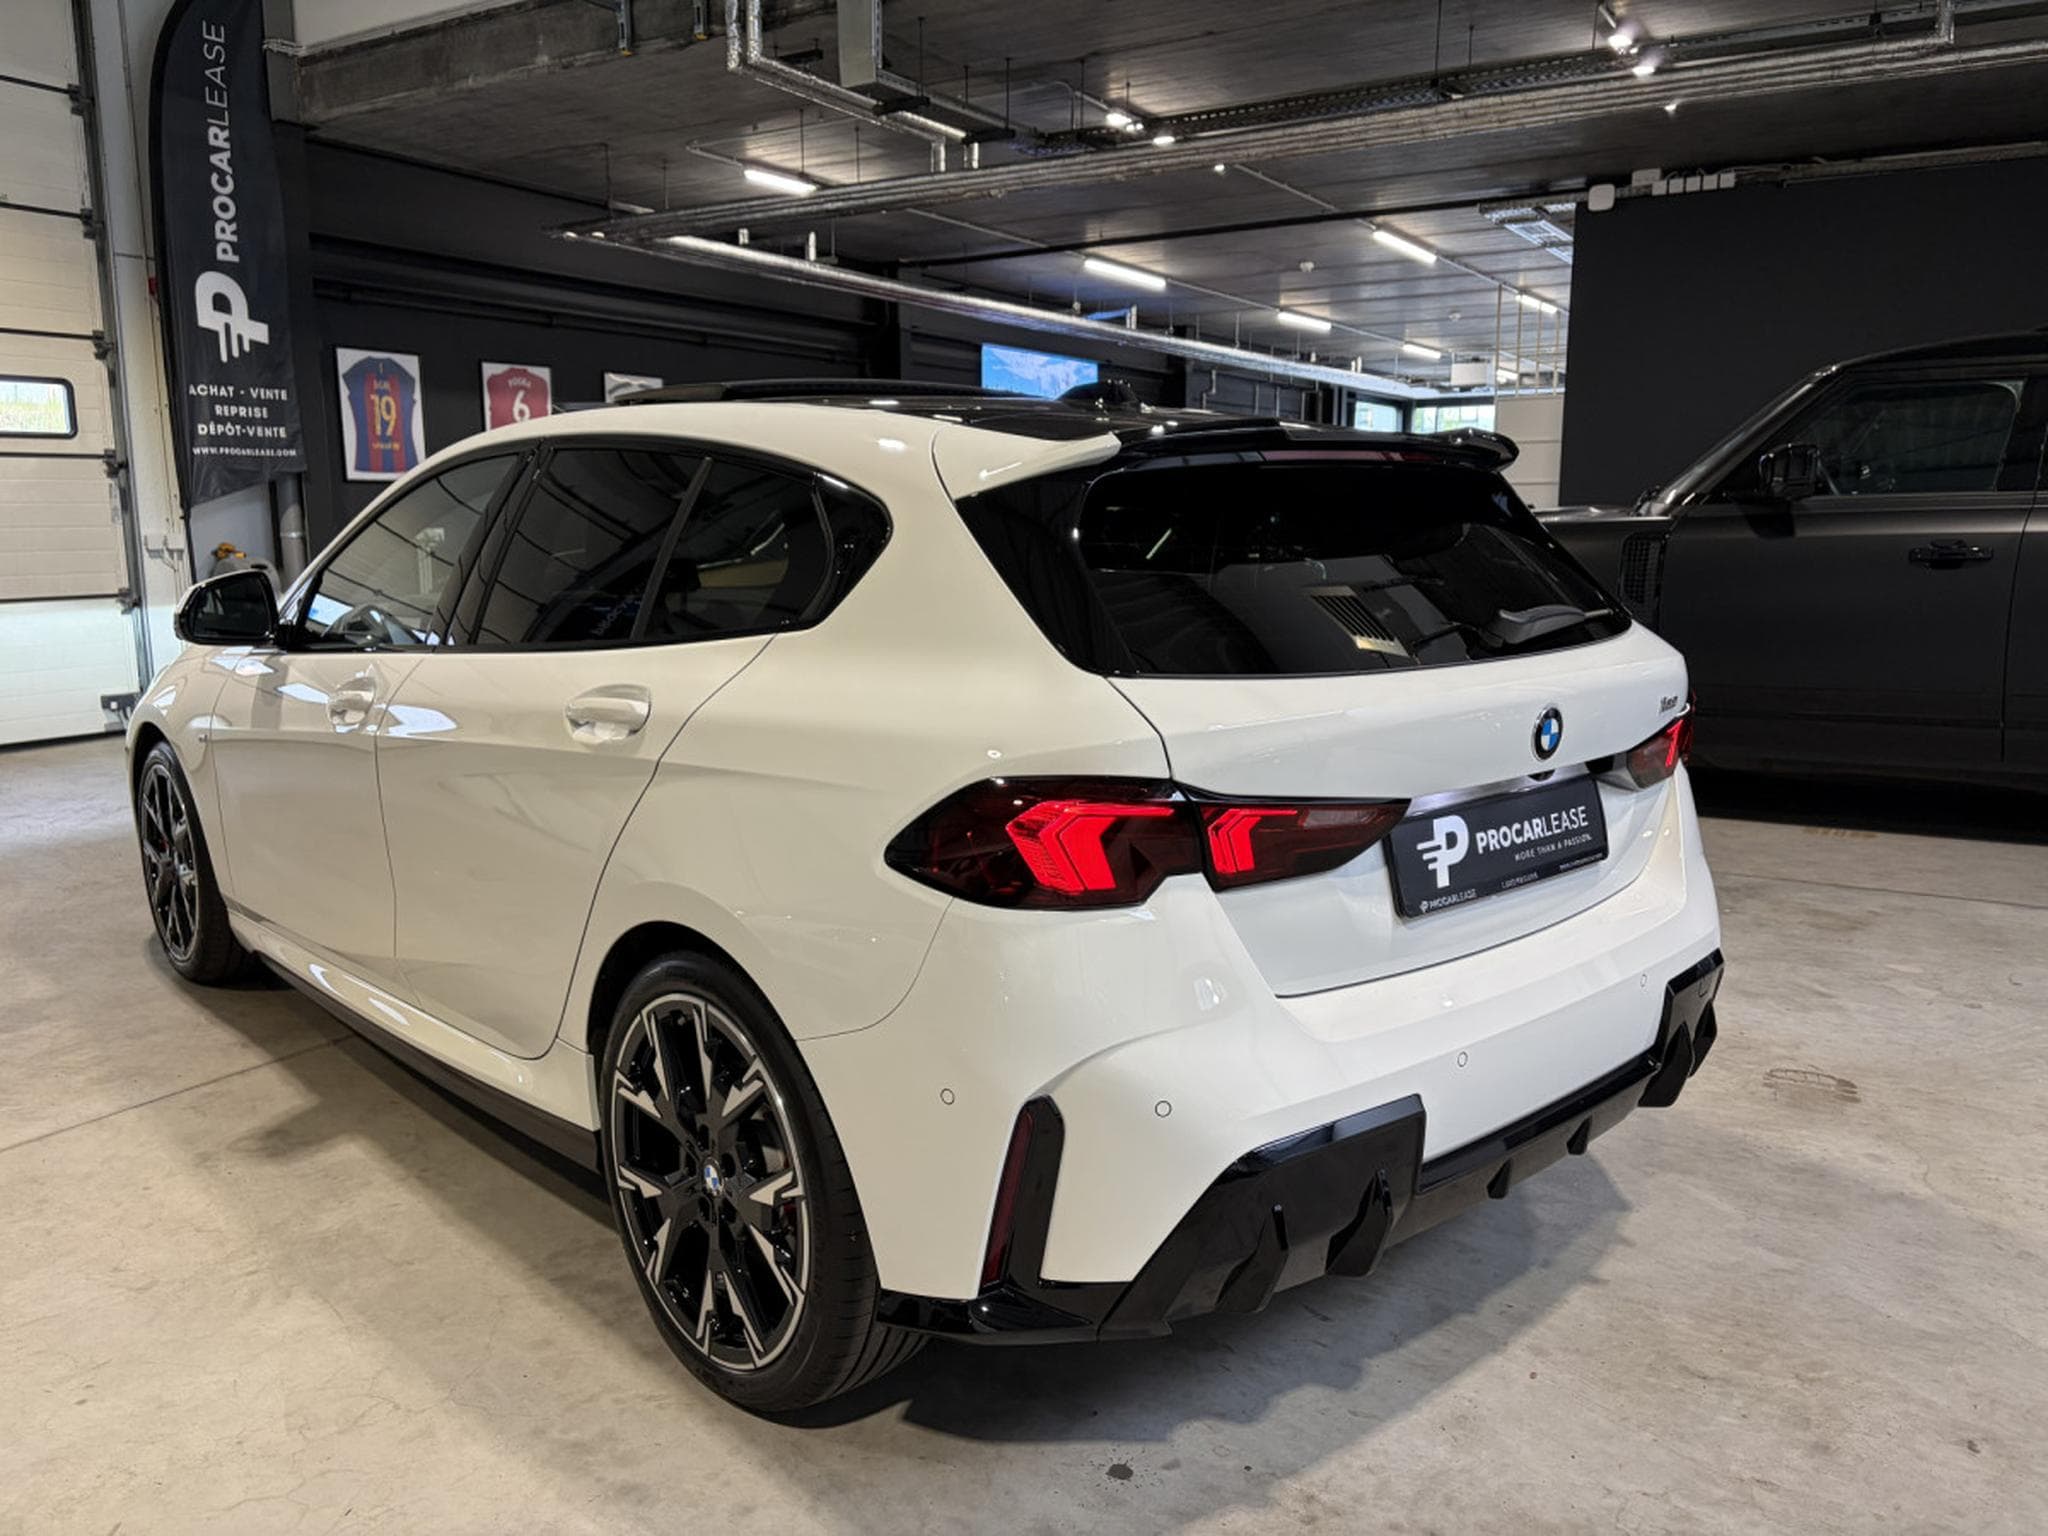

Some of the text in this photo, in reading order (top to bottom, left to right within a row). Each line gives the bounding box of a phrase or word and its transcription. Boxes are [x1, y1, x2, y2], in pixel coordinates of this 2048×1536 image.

[203, 21, 239, 263] PROCARLEASE
[189, 384, 235, 398] ACHAT
[250, 387, 288, 400] VENTE
[512, 390, 531, 422] 6
[214, 404, 268, 418] REPRISE
[369, 394, 396, 436] 19
[1476, 806, 1589, 854] PROCARLEASE
[1515, 849, 1536, 862] MORE
[1538, 843, 1556, 857] THAN
